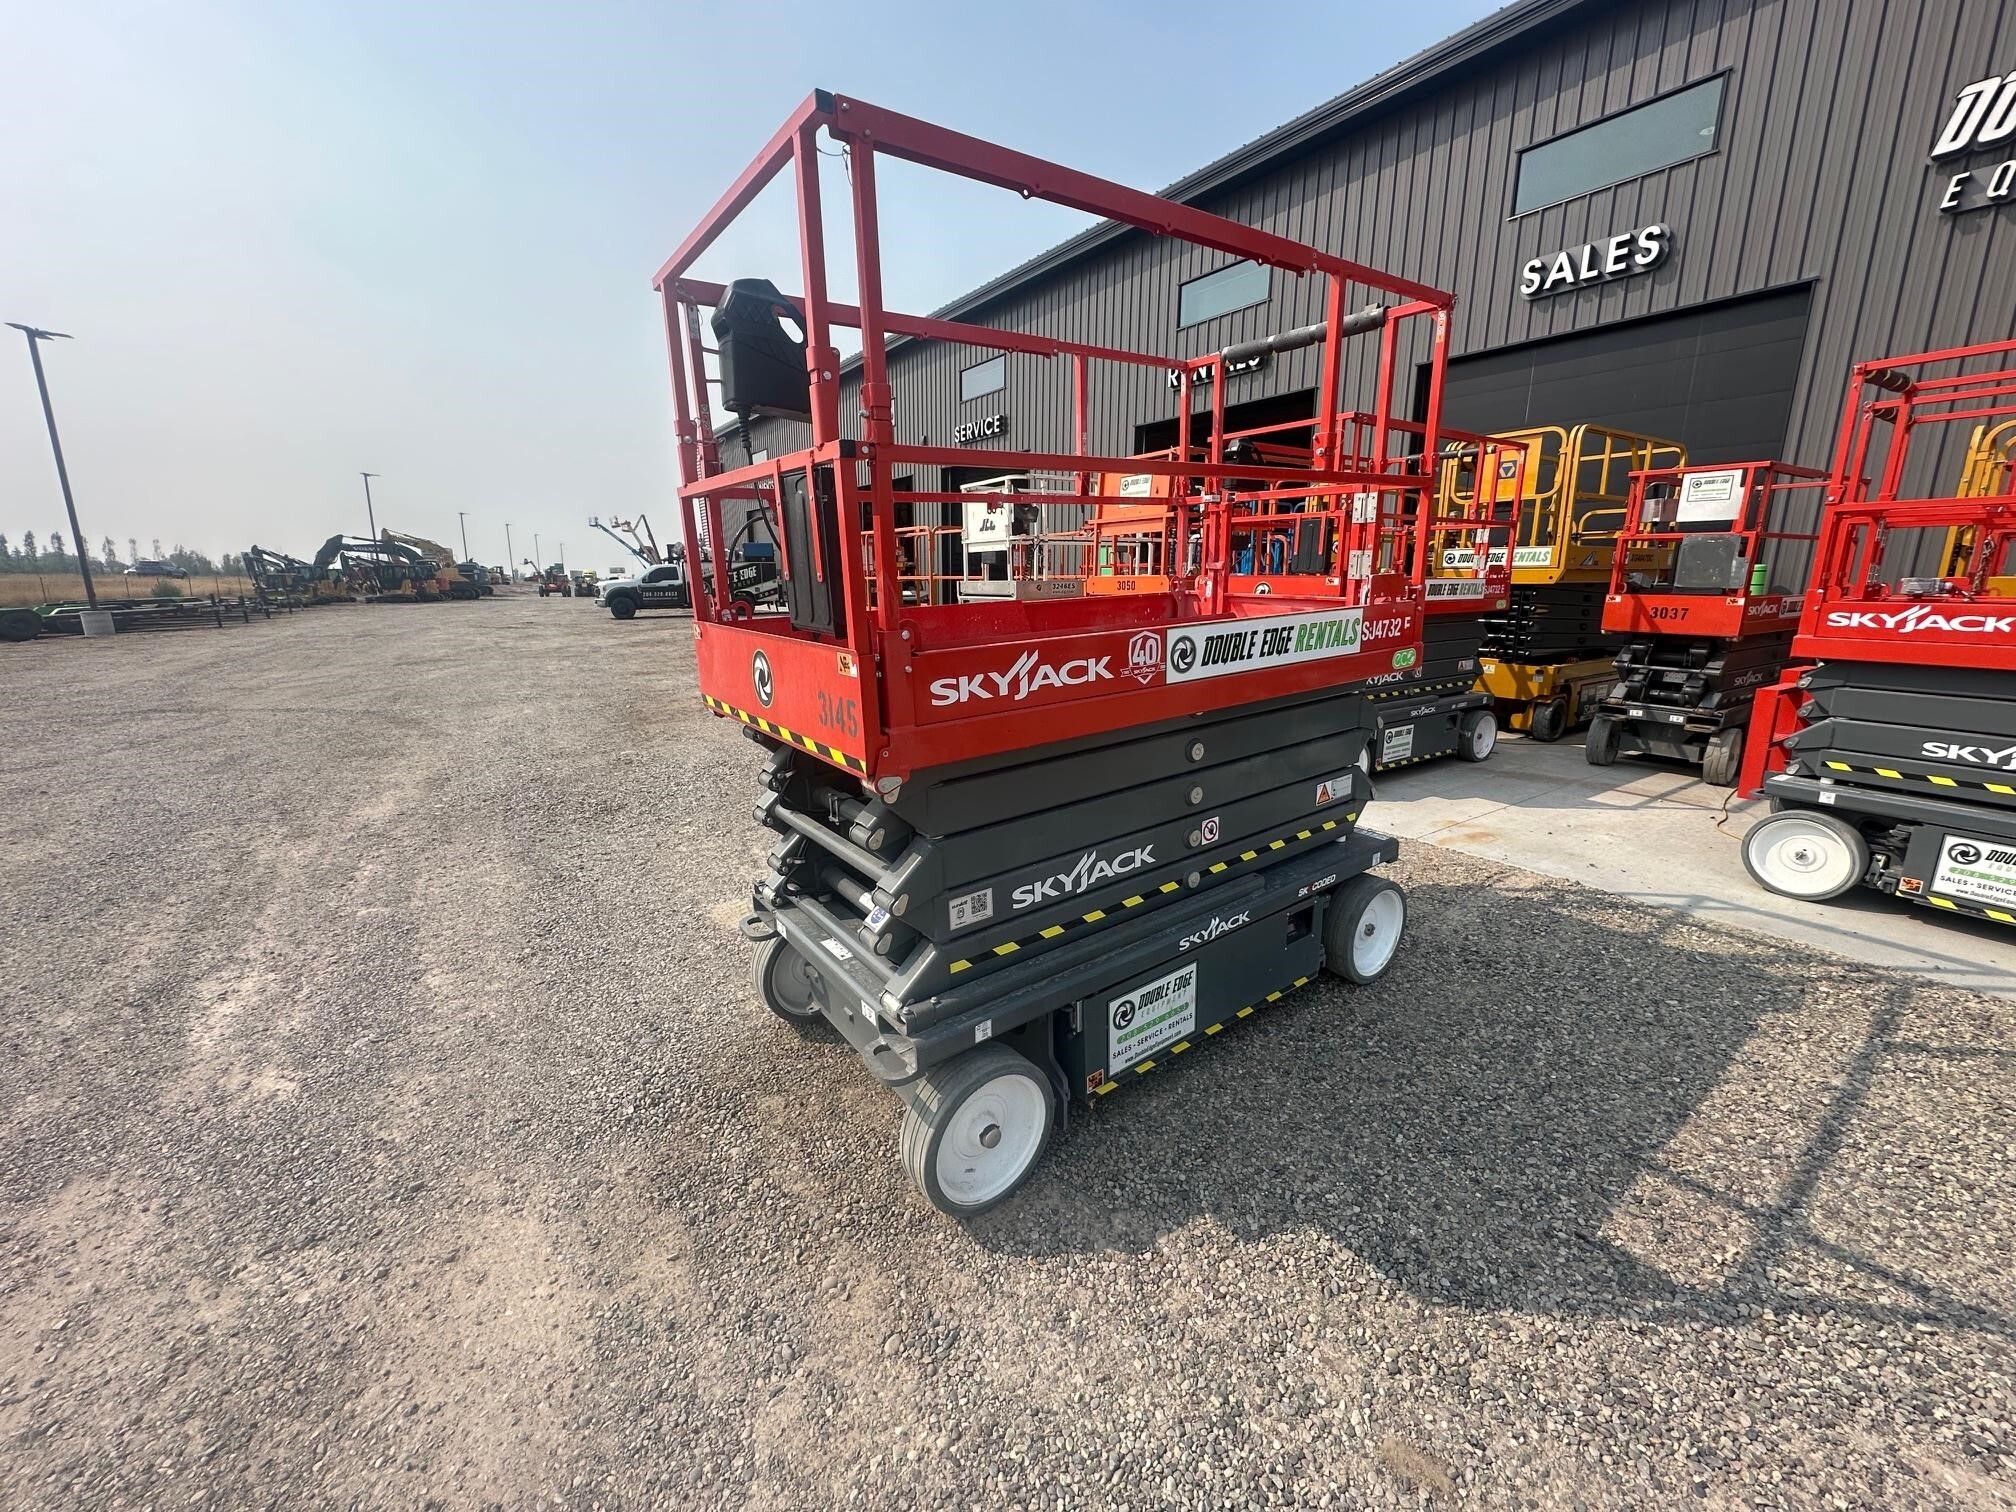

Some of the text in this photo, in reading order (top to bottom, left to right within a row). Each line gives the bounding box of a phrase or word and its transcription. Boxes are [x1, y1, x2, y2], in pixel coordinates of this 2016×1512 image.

[1520, 225, 1661, 295] SALES
[954, 414, 1000, 443] SERVICE
[1487, 552, 1506, 562] EDGE
[1514, 551, 1550, 562] ENTALS
[740, 565, 757, 580] EDGE
[1117, 580, 1136, 591] 3050
[1427, 582, 1484, 596] DOUBLE EDGE RENTALS
[1650, 606, 1689, 621] 3037
[1748, 600, 1779, 616] SKYJACK
[1826, 604, 2016, 633] SKYJACK
[1362, 618, 1402, 641] SJ4732
[1132, 637, 1157, 666] 40
[1200, 617, 1361, 666] DOUBLE EDGE RENTALS
[929, 649, 1114, 706] SKYJACK
[1366, 671, 1404, 685] KYJACK
[1733, 670, 1764, 686] SKYJACK
[817, 690, 858, 738] 3145
[1410, 706, 1436, 717] SKYJACK
[1984, 849, 2016, 866] DOU
[1011, 844, 1156, 909] SKYJACK
[1940, 875, 1968, 886] SALES
[1178, 910, 1250, 951] SKYJACK
[1138, 970, 1193, 1011] DOUBLE EDGE
[1112, 1012, 1193, 1060] SALES SERVICE RENTALS
